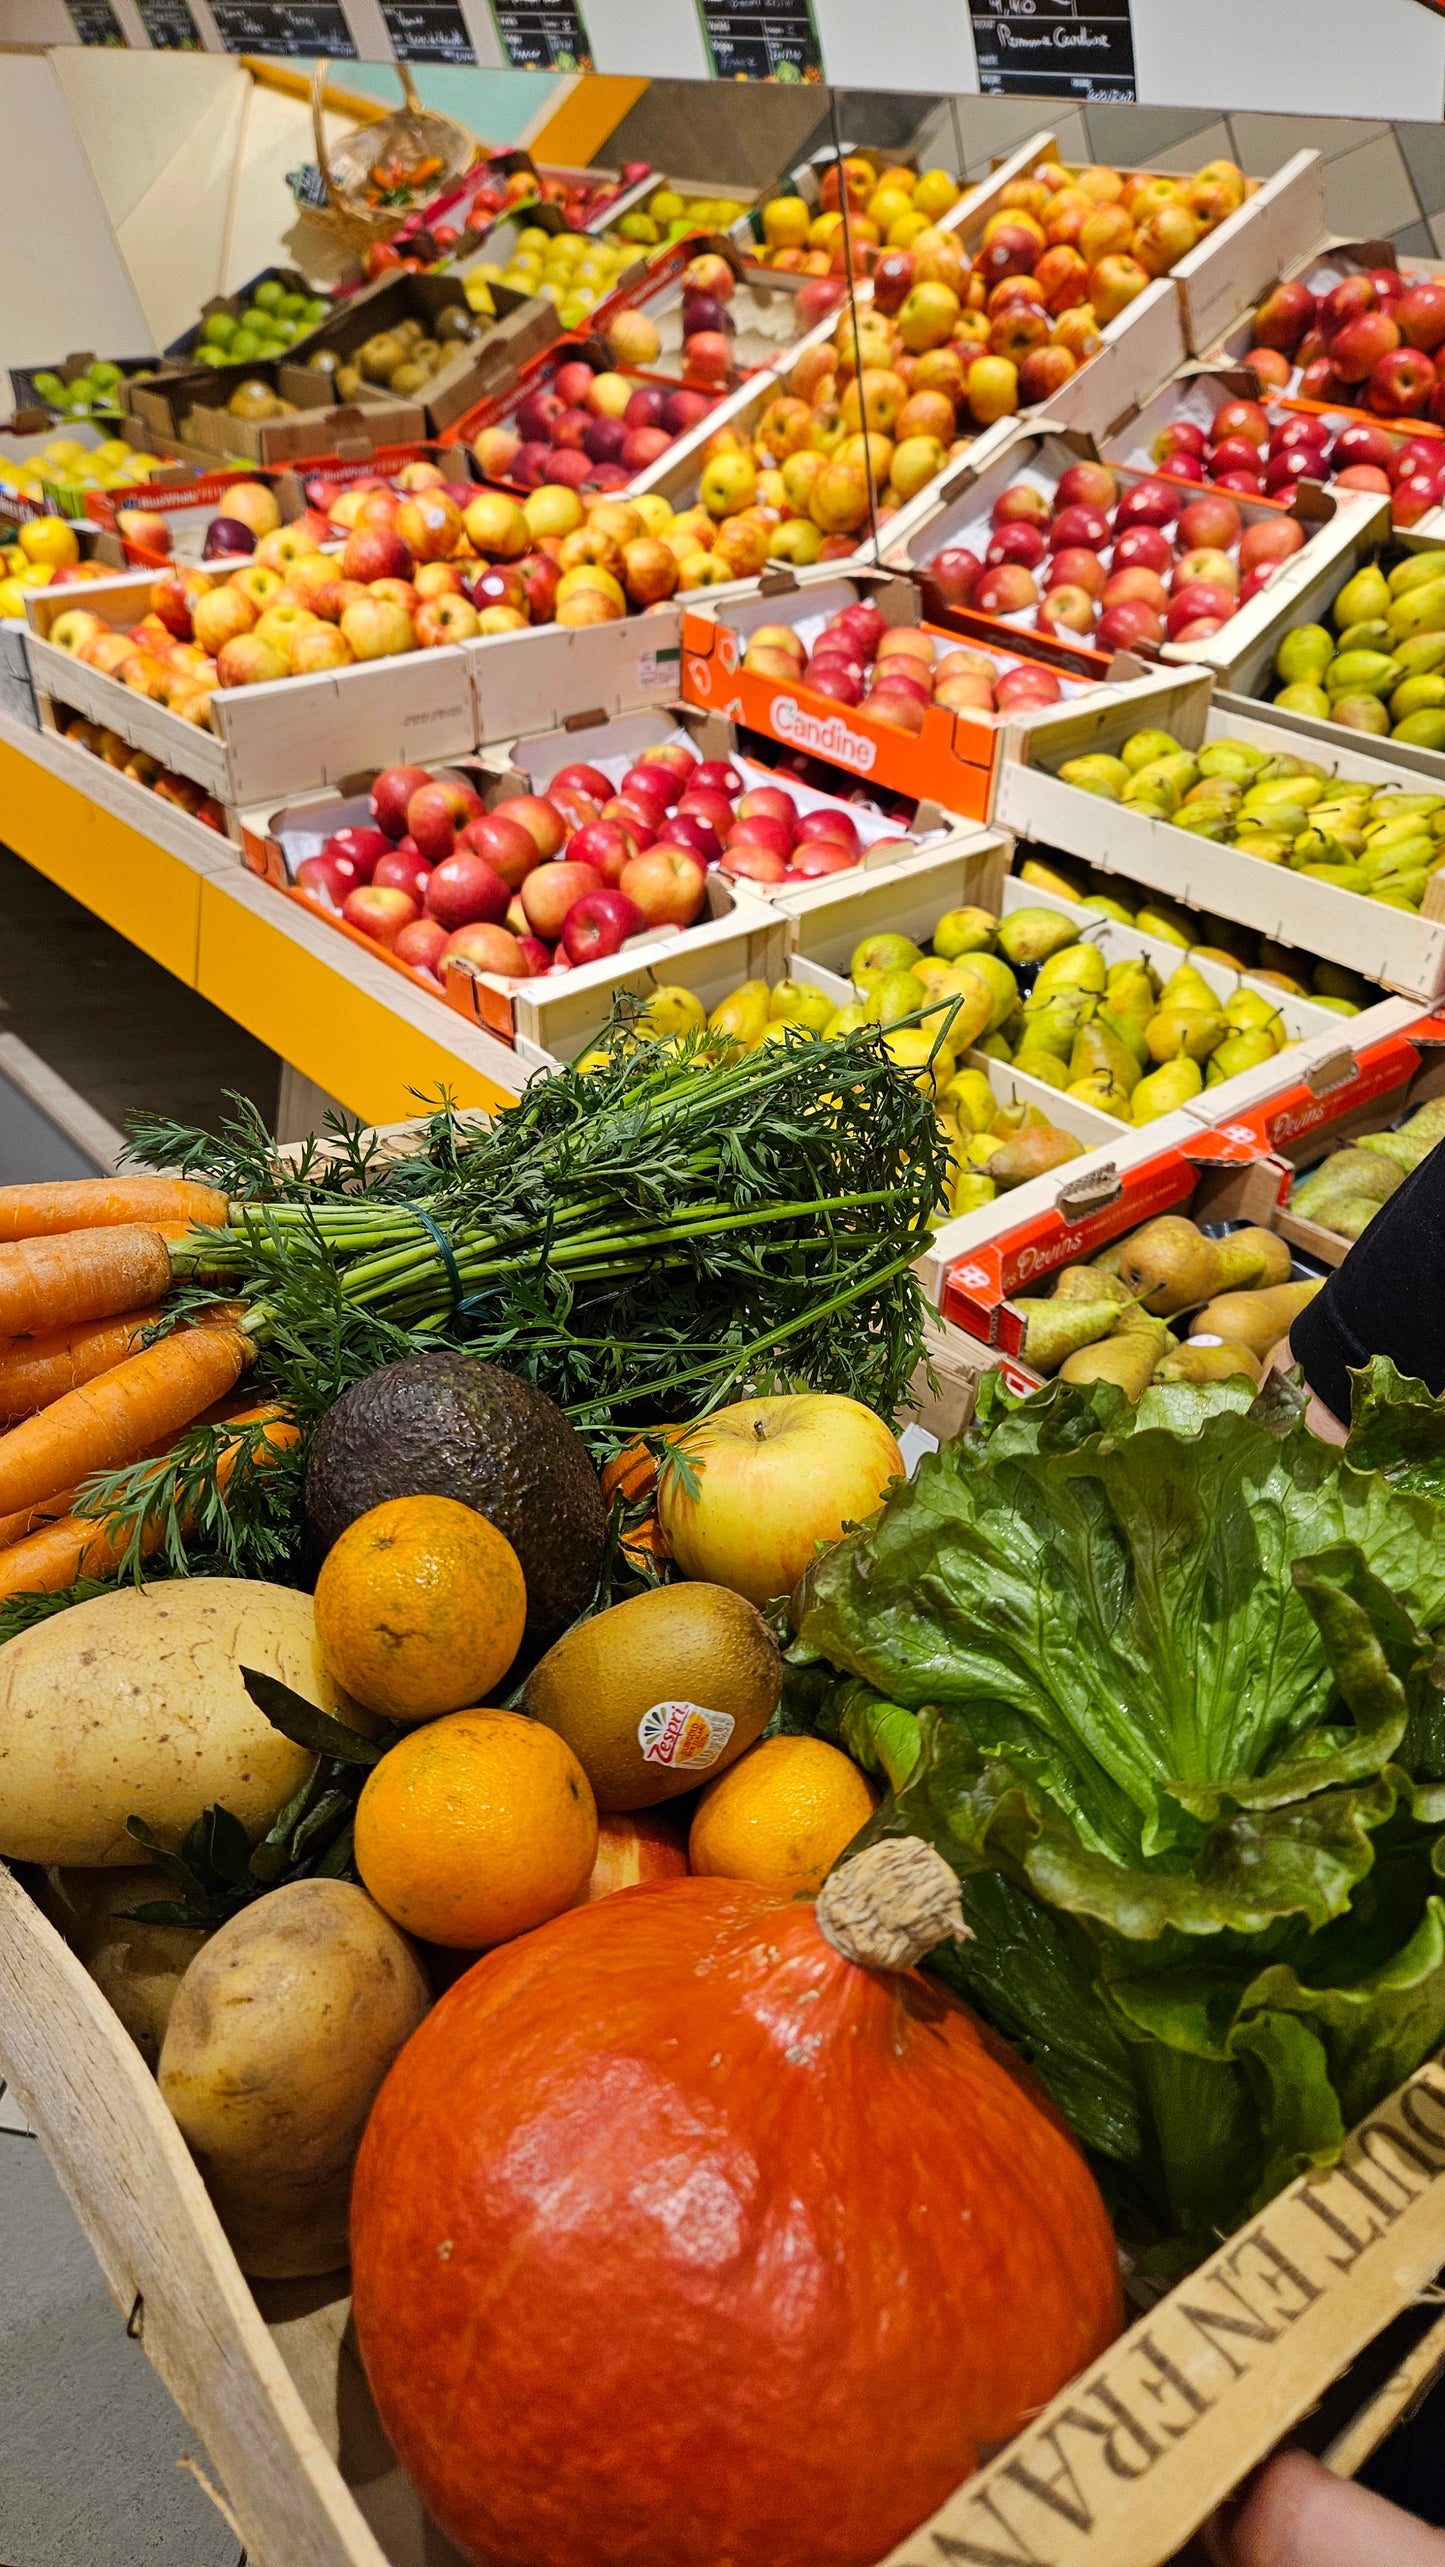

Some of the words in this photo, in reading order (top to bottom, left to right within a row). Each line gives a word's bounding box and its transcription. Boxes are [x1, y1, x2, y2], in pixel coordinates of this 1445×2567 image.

[773, 699, 873, 767] Candine
[1273, 1097, 1325, 1145] Devins
[1017, 1230, 1083, 1280] Devins
[646, 1705, 690, 1764] Zespri
[1292, 2046, 1445, 2273] DUIT
[1174, 2224, 1328, 2380] EN
[885, 2332, 1219, 2567] FRAN
